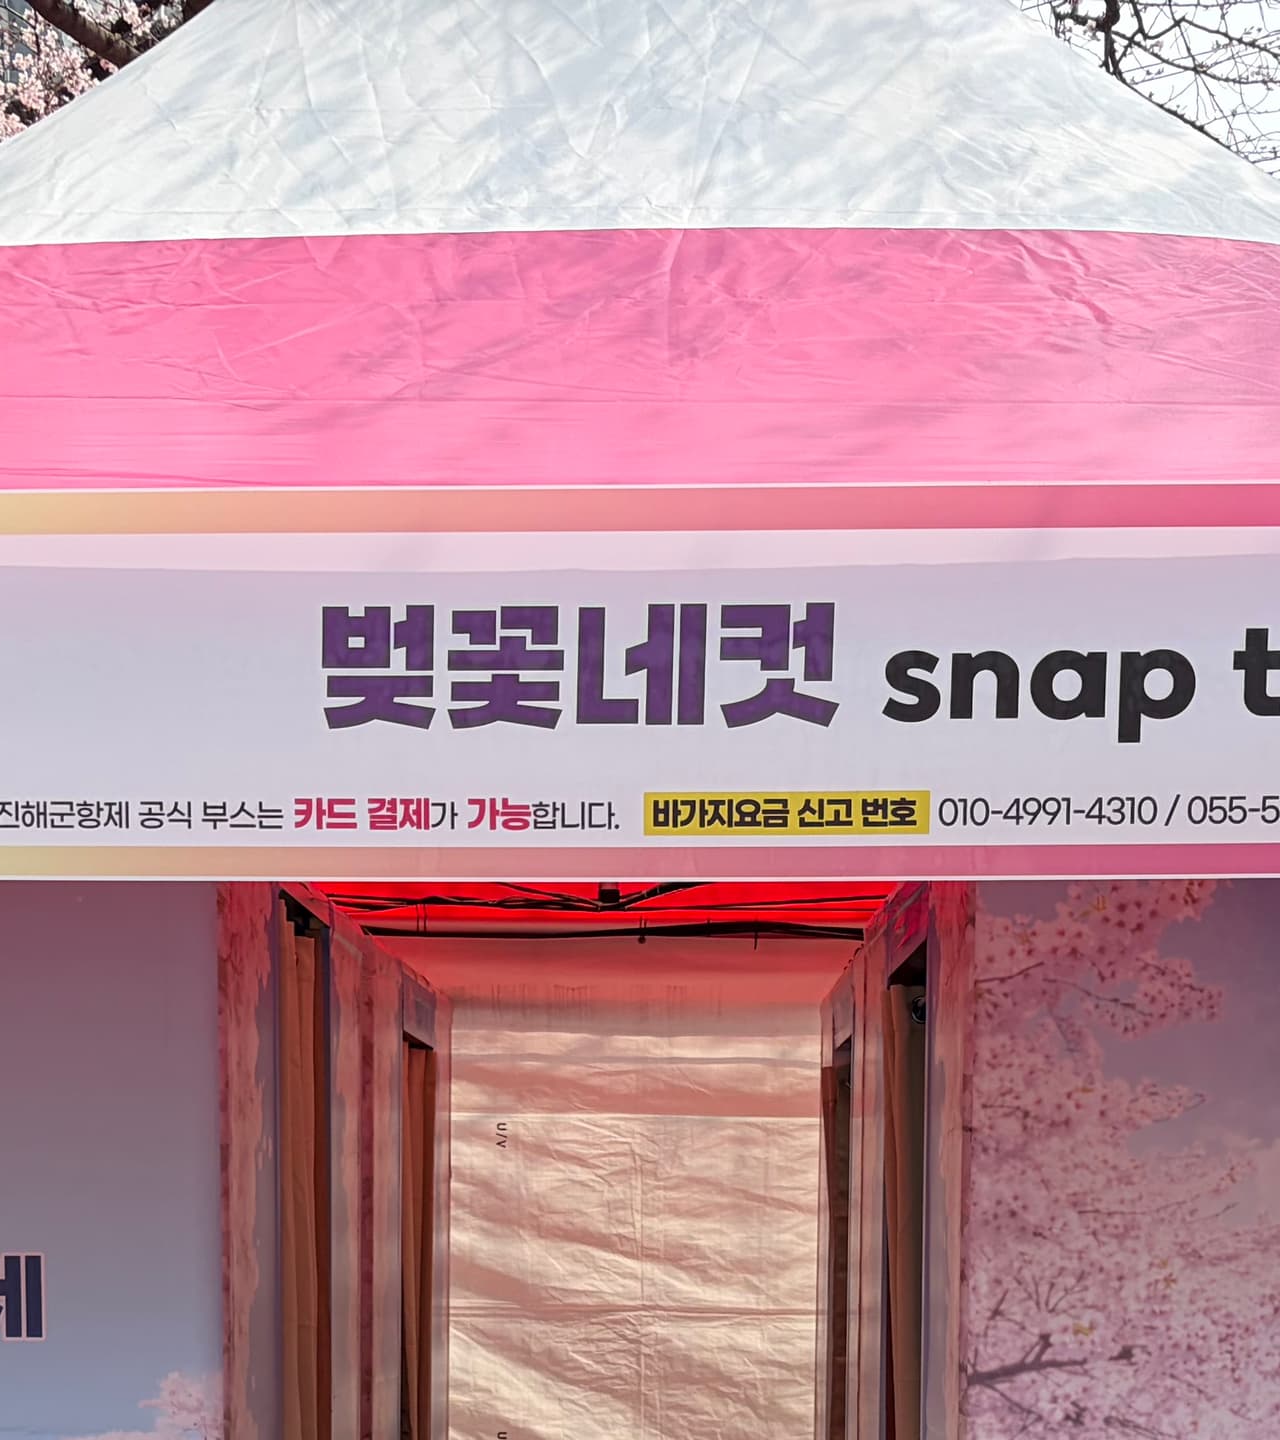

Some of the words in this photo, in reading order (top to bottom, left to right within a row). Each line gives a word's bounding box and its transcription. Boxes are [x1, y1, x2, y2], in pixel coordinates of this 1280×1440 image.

[321, 602, 839, 731] 벚꽃네컷
[883, 645, 1196, 743] snap
[138, 800, 192, 829] 공식
[201, 800, 284, 829] 부스는
[294, 797, 358, 830] 카드
[367, 797, 458, 830] 결제가
[467, 797, 620, 830] 가능합니다.
[652, 799, 790, 828] 바가지요금
[797, 798, 853, 828] 신고
[861, 797, 917, 828] 번호
[938, 797, 1157, 826] 010-4991-4310
